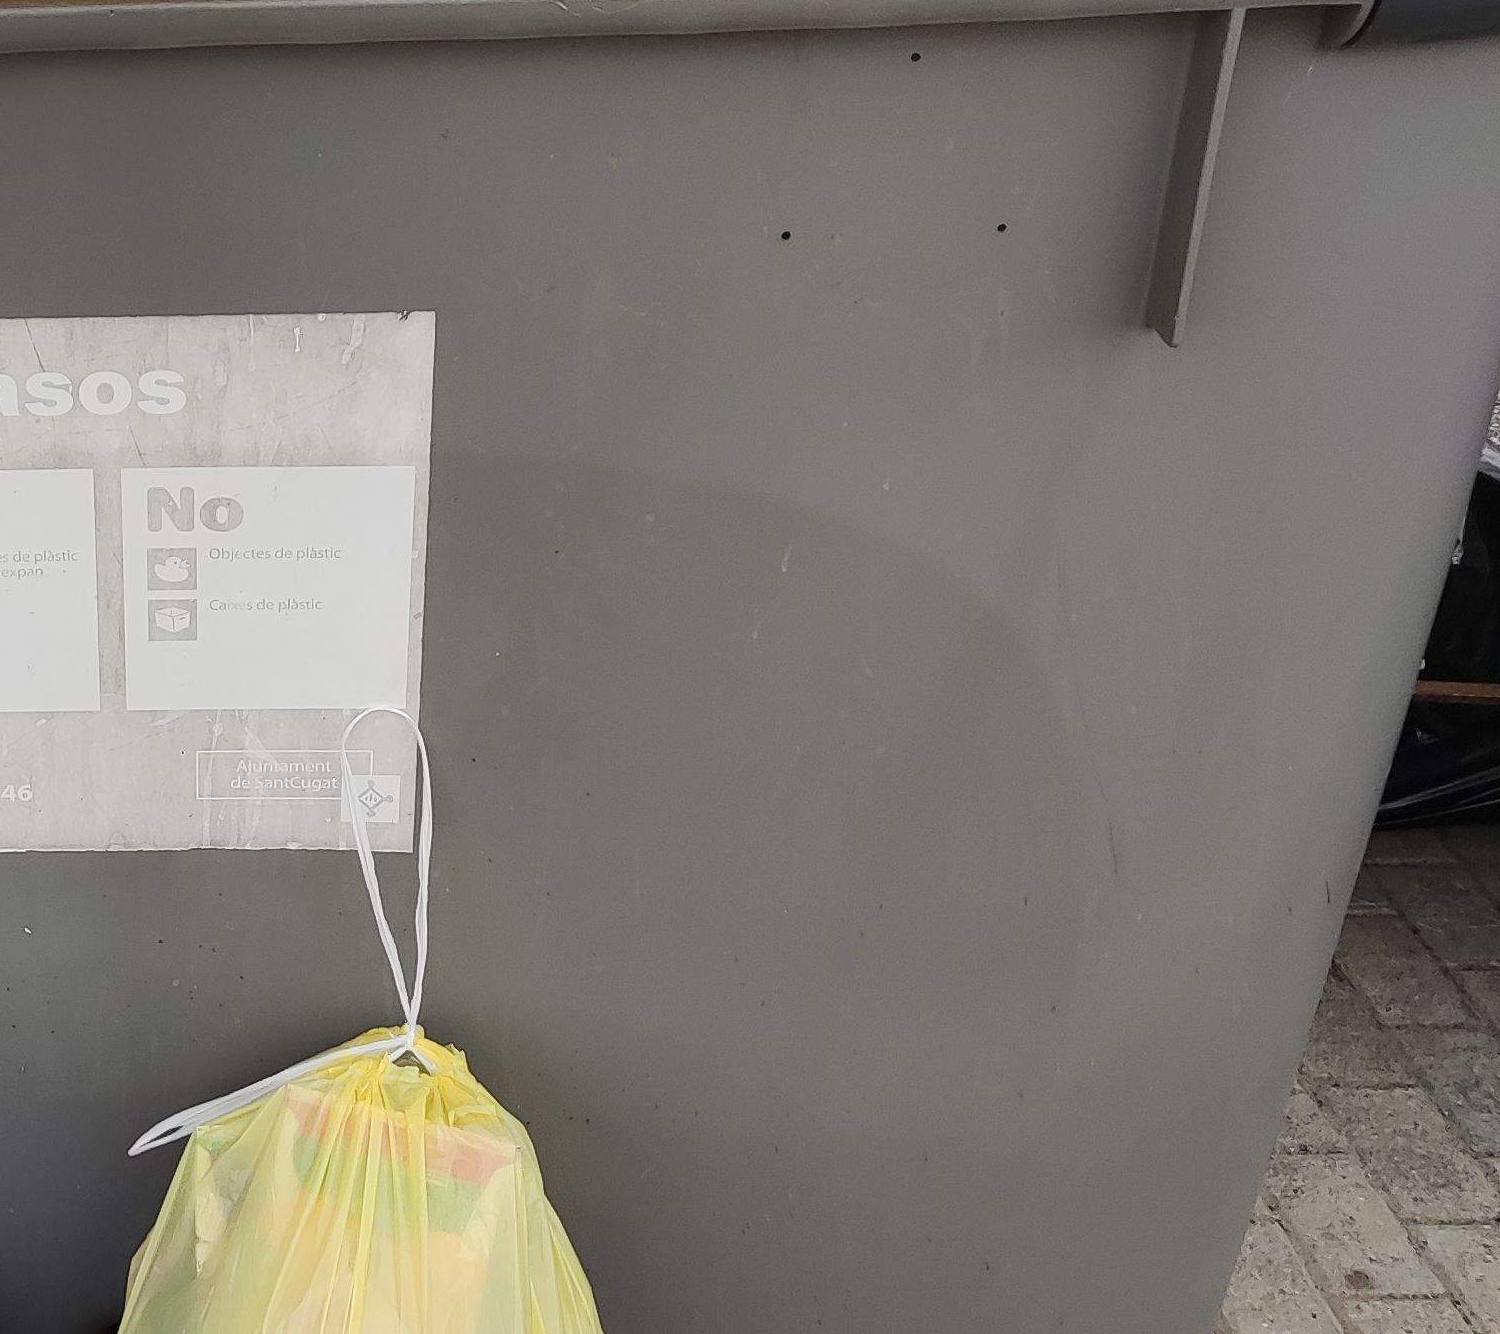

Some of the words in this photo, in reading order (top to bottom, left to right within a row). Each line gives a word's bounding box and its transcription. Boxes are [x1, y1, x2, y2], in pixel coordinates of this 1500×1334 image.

[147, 486, 244, 533] No
[12, 551, 30, 563] de
[208, 547, 271, 562] Objectes
[274, 546, 293, 560] de
[208, 597, 253, 611] Caixes
[256, 596, 274, 611] de
[236, 759, 332, 774] Ajuntament
[230, 775, 249, 789] de
